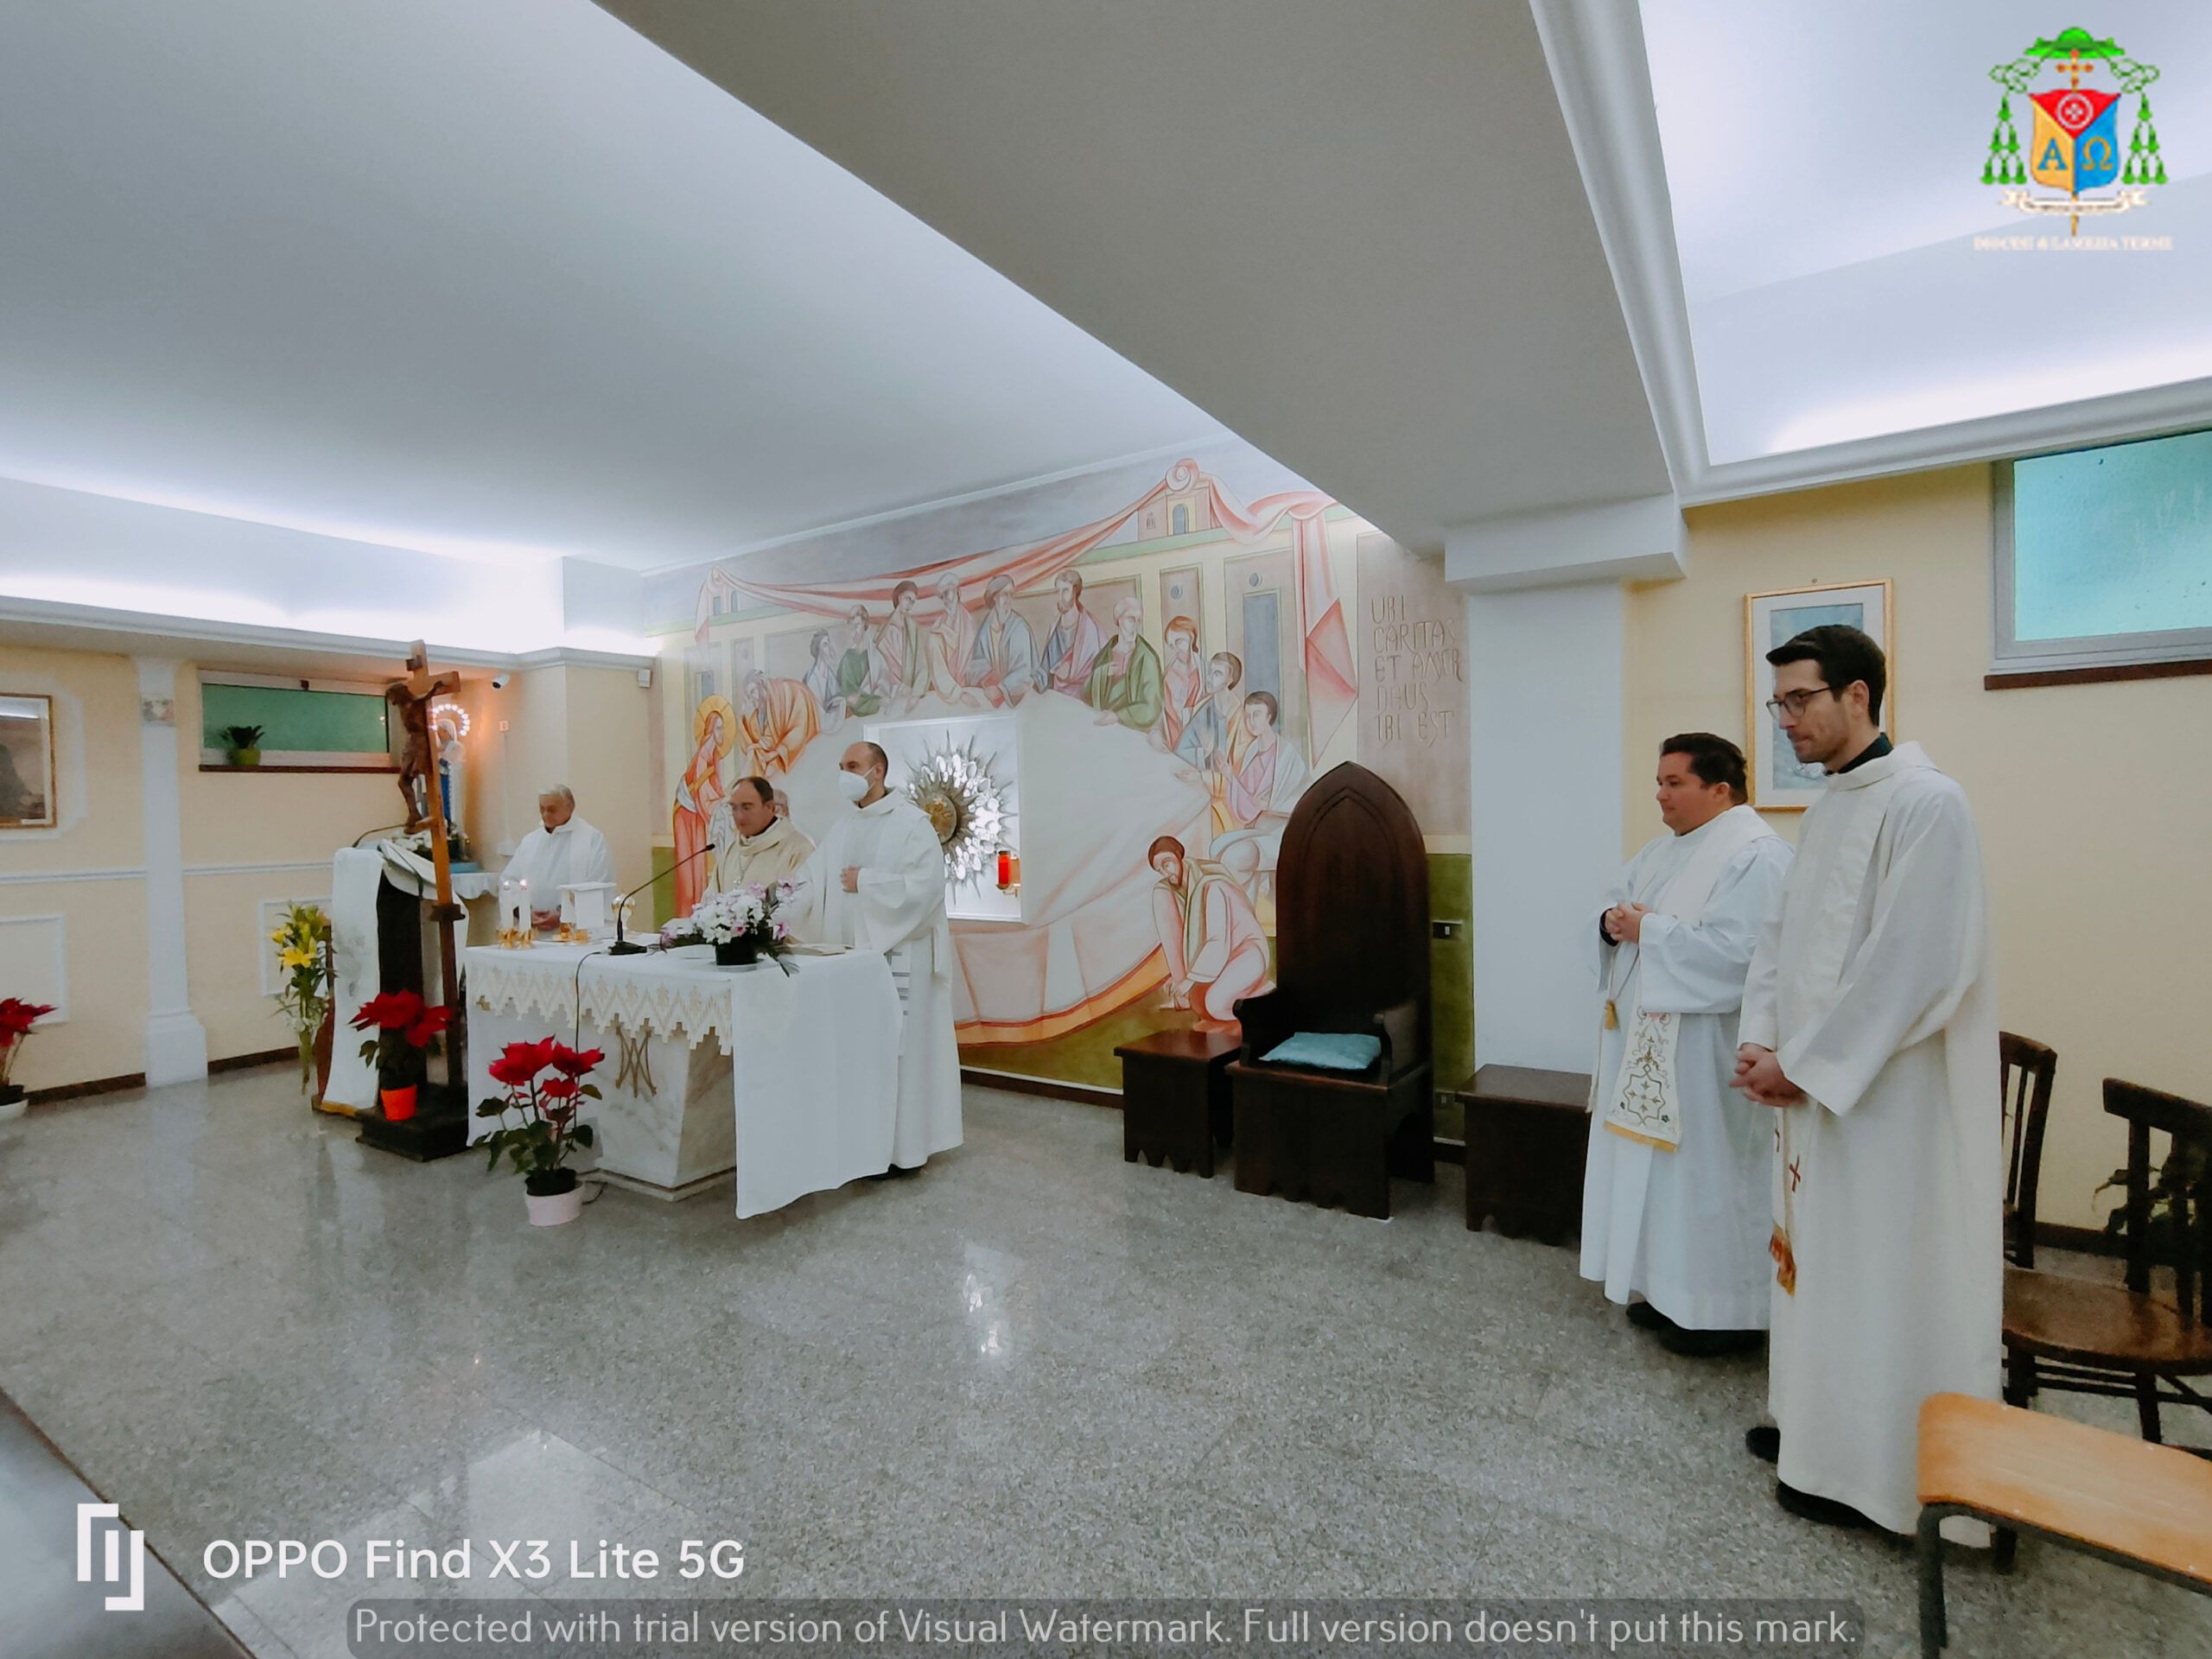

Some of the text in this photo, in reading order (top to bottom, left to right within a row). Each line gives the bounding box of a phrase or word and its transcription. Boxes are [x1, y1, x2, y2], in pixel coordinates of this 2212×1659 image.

[1371, 594, 1406, 624] UBI
[1374, 618, 1457, 653] CARITAS
[1375, 655, 1402, 682] ET
[1377, 681, 1429, 712] DEUS
[1376, 709, 1455, 748] IBI EST
